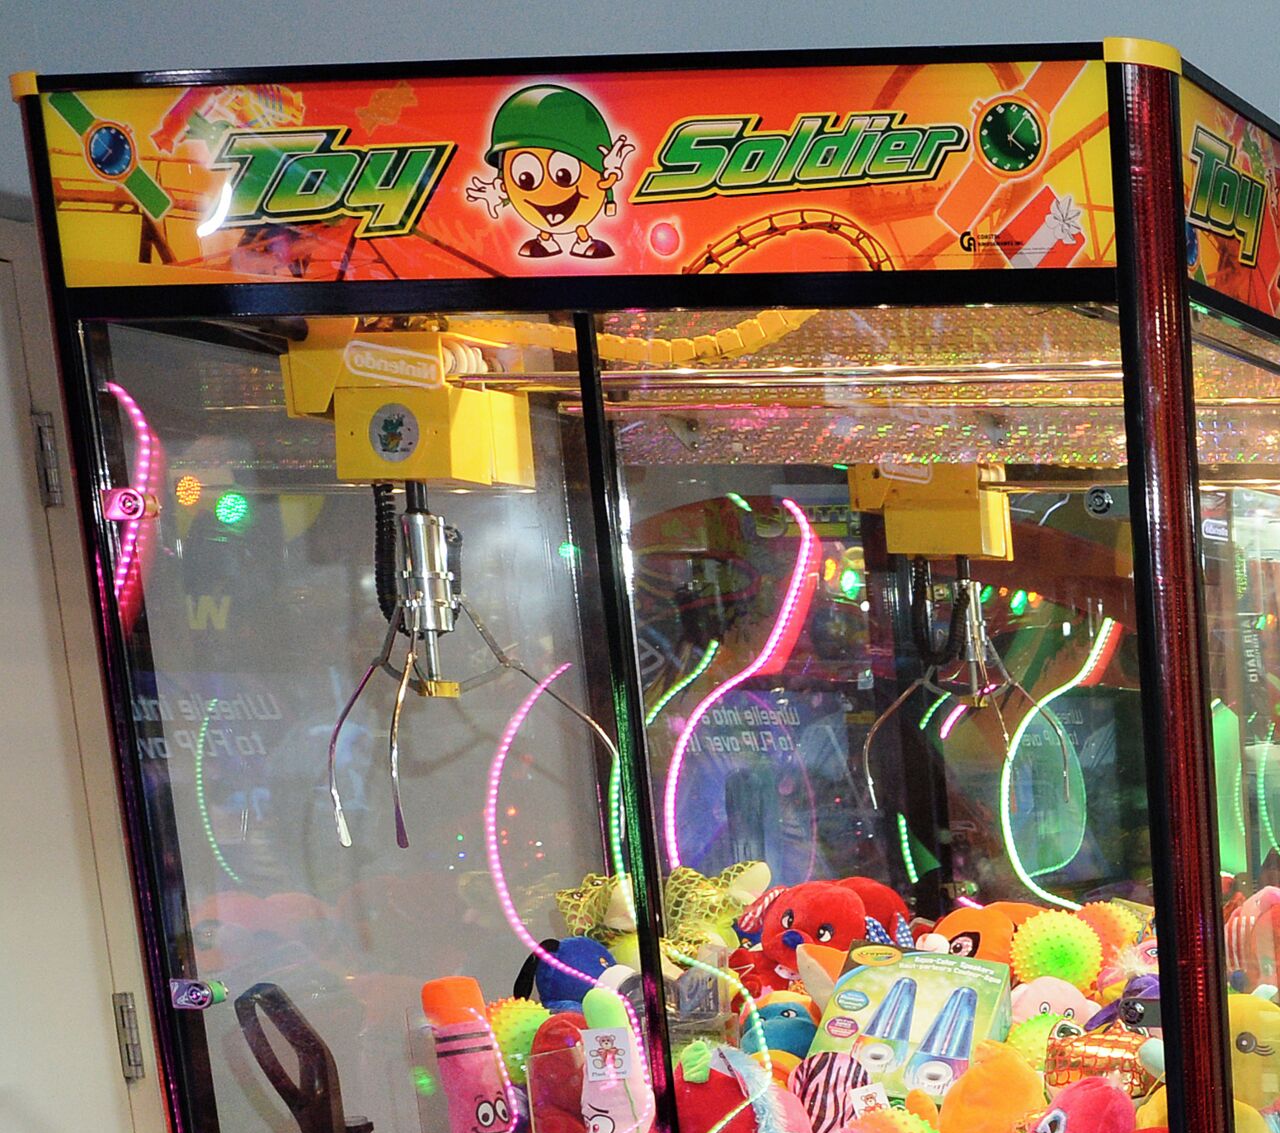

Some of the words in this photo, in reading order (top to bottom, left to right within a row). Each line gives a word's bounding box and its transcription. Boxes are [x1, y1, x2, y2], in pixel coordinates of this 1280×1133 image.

[210, 127, 455, 237] Toy
[633, 111, 968, 202] Soldier
[1187, 122, 1267, 267] Toy
